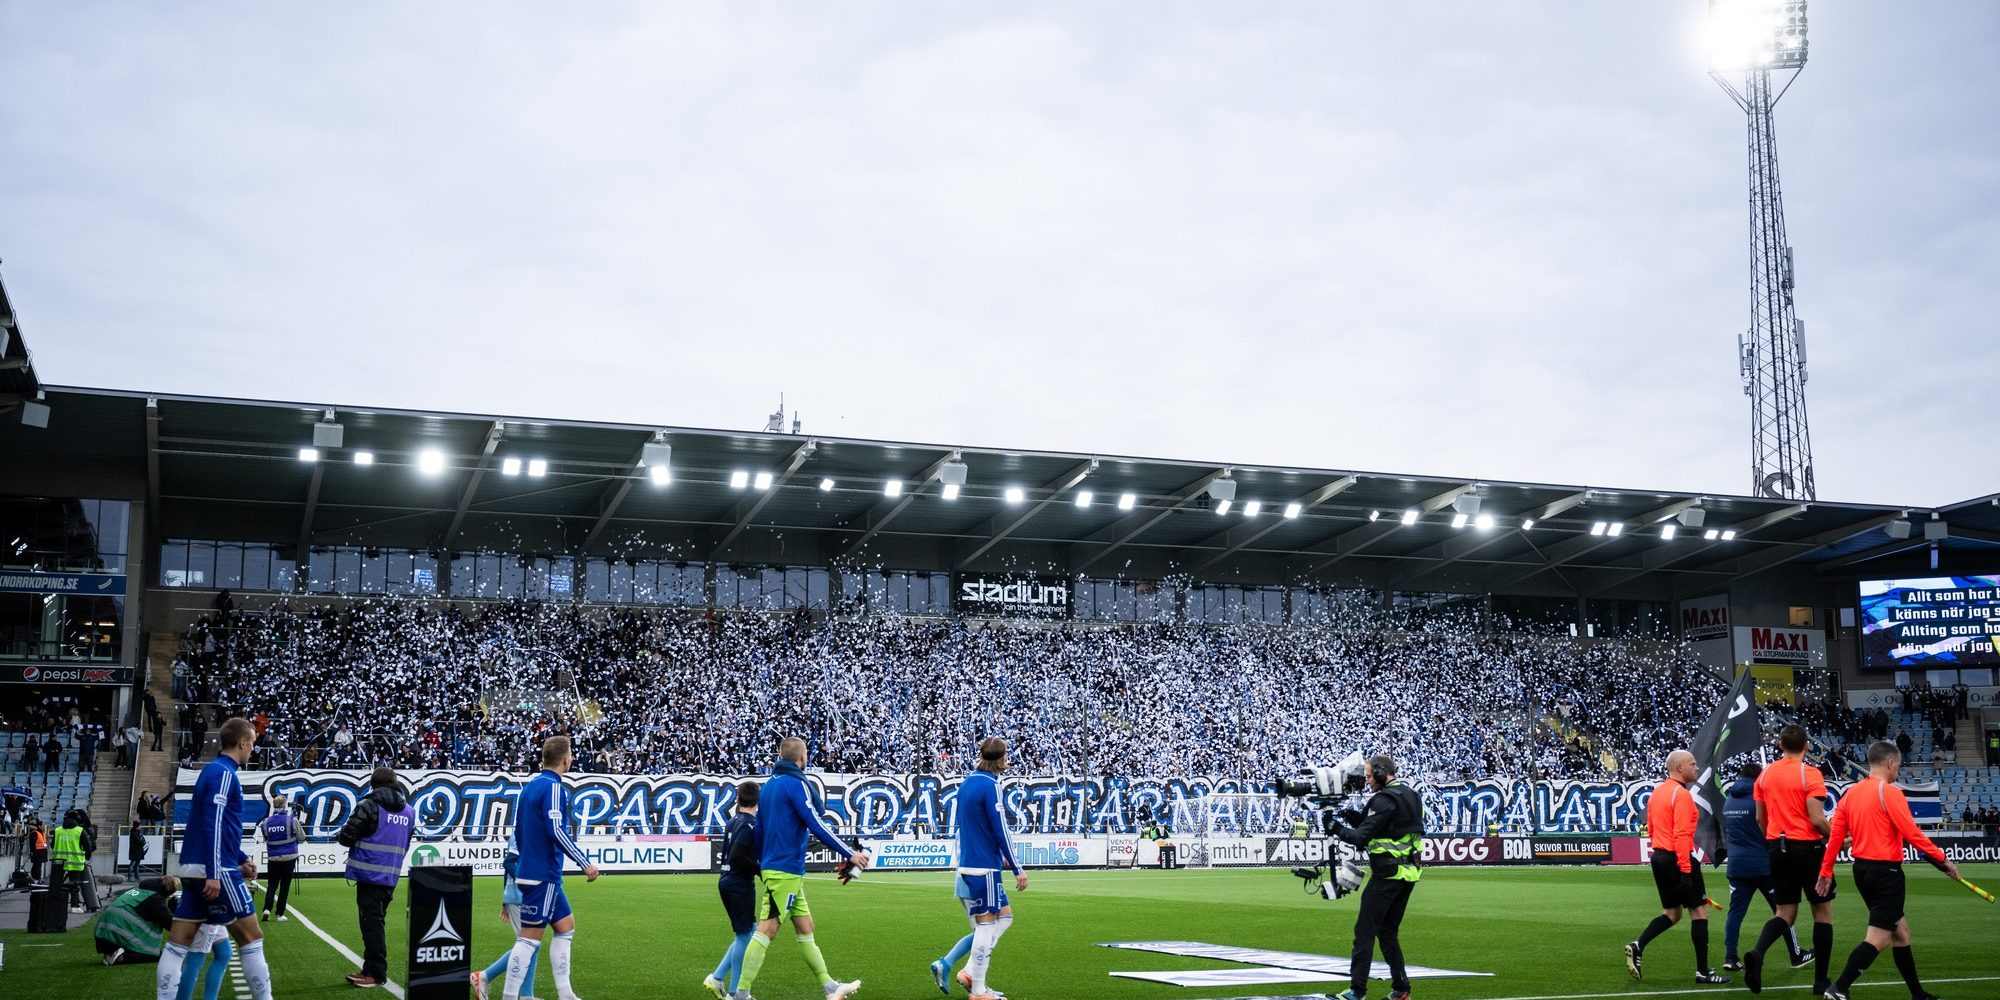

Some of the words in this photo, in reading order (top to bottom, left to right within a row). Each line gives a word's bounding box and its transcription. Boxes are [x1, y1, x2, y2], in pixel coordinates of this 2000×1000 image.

[962, 579, 1066, 605] stadium
[1908, 591, 1932, 603] Allt
[1935, 592, 1965, 601] som
[1968, 588, 1993, 600] har
[1682, 607, 1727, 629] MAXI
[1895, 609, 1937, 620] känns
[1941, 608, 1965, 618] när
[1968, 606, 1991, 619] jag
[1902, 625, 1947, 637] Allting
[1951, 625, 1980, 634] som
[1751, 628, 1808, 651] MAXI
[1763, 650, 1809, 659] STORMARKNAD
[1898, 642, 1940, 654] känns
[1945, 642, 1967, 652] när
[1970, 641, 1993, 653] jag
[43, 669, 80, 681] pepsi
[387, 814, 408, 826] FOTO
[268, 825, 285, 833] FOTO
[1180, 843, 1200, 859] DS
[1421, 838, 1489, 861] BYGG
[1503, 839, 1532, 859] BOA
[1534, 843, 1562, 852] SKIVOR
[1564, 843, 1580, 852] TILL
[1581, 843, 1610, 852] BYGGET
[586, 848, 683, 864] HOLMEN
[883, 857, 931, 866] VERKSTAD
[933, 857, 946, 865] AB
[245, 904, 251, 914] 2
[416, 946, 465, 963] SELECT
